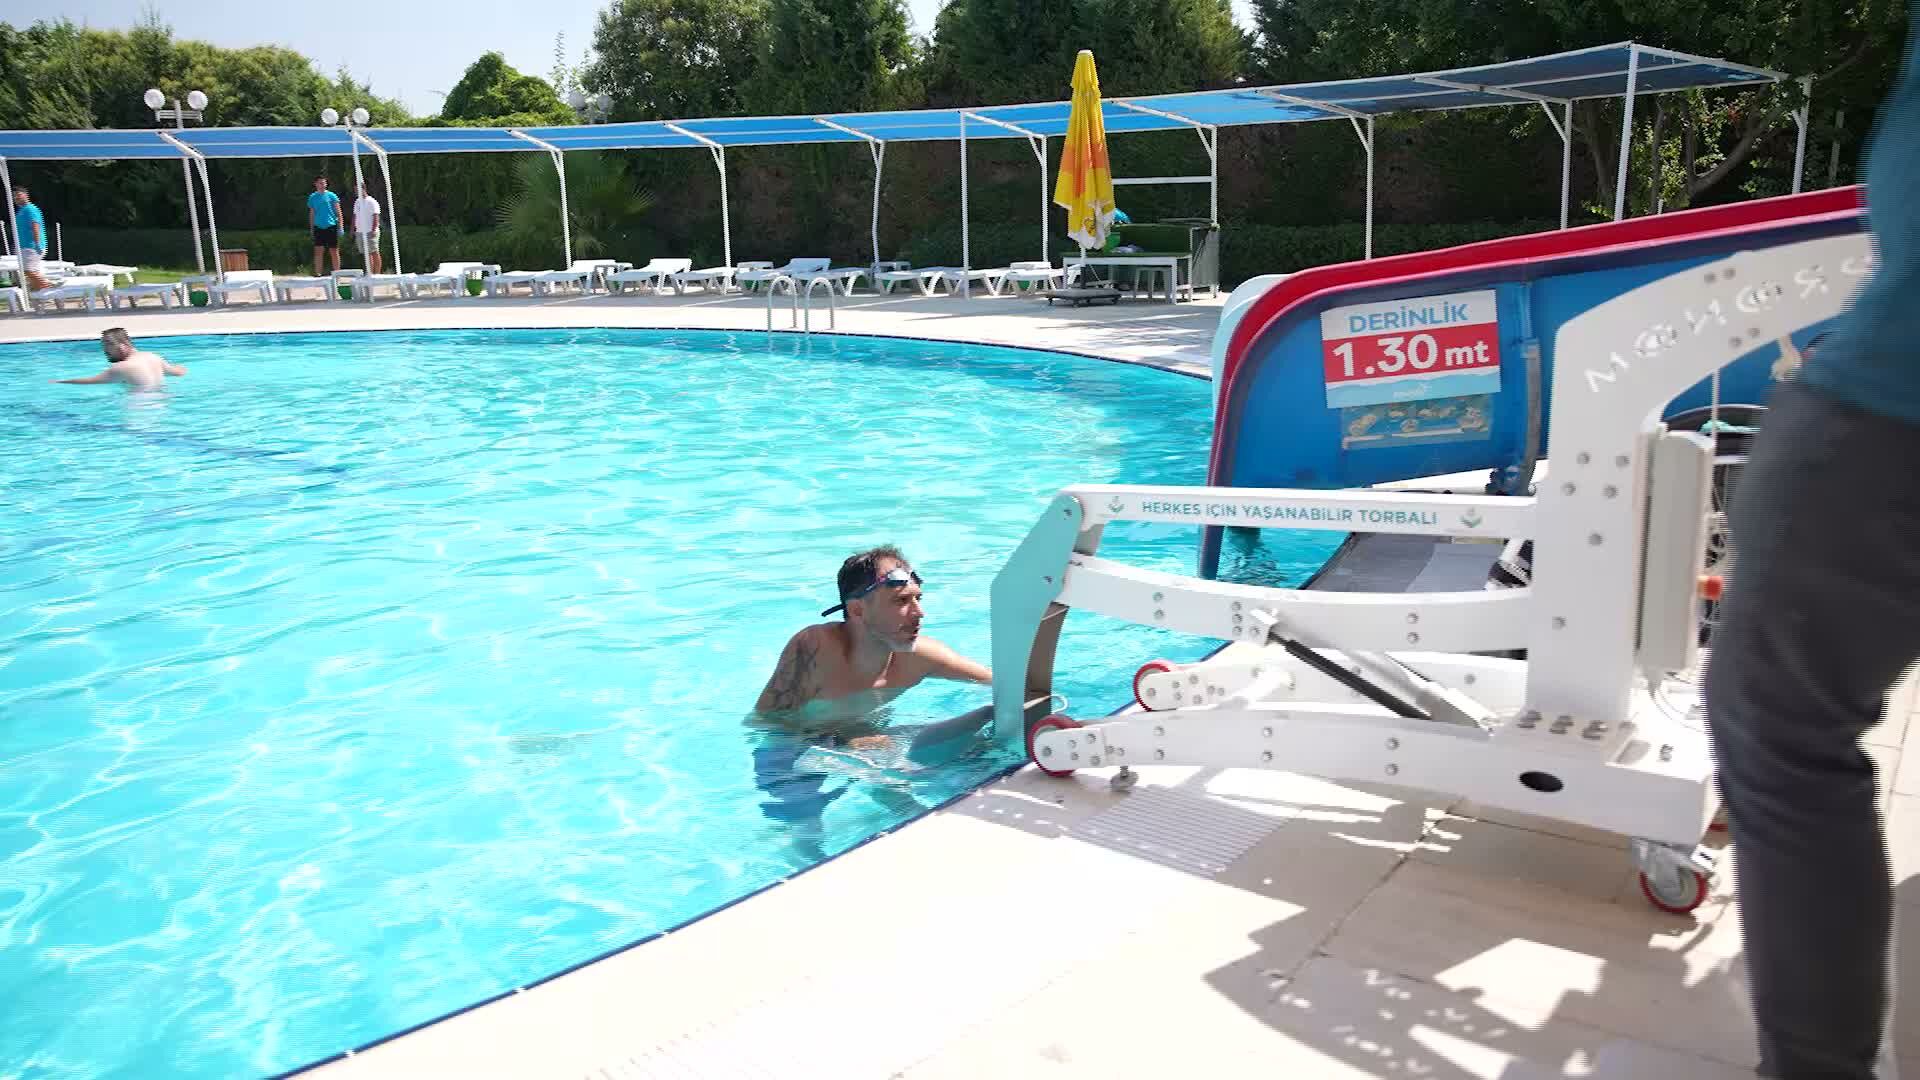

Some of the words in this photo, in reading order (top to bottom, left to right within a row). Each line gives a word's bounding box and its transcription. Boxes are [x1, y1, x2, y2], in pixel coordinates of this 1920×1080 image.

[1349, 301, 1469, 333] DERİNLİK
[1332, 333, 1439, 377] 1.30
[1444, 340, 1490, 366] mt
[1142, 501, 1201, 515] HERKES
[1358, 508, 1439, 525] TORBALI
